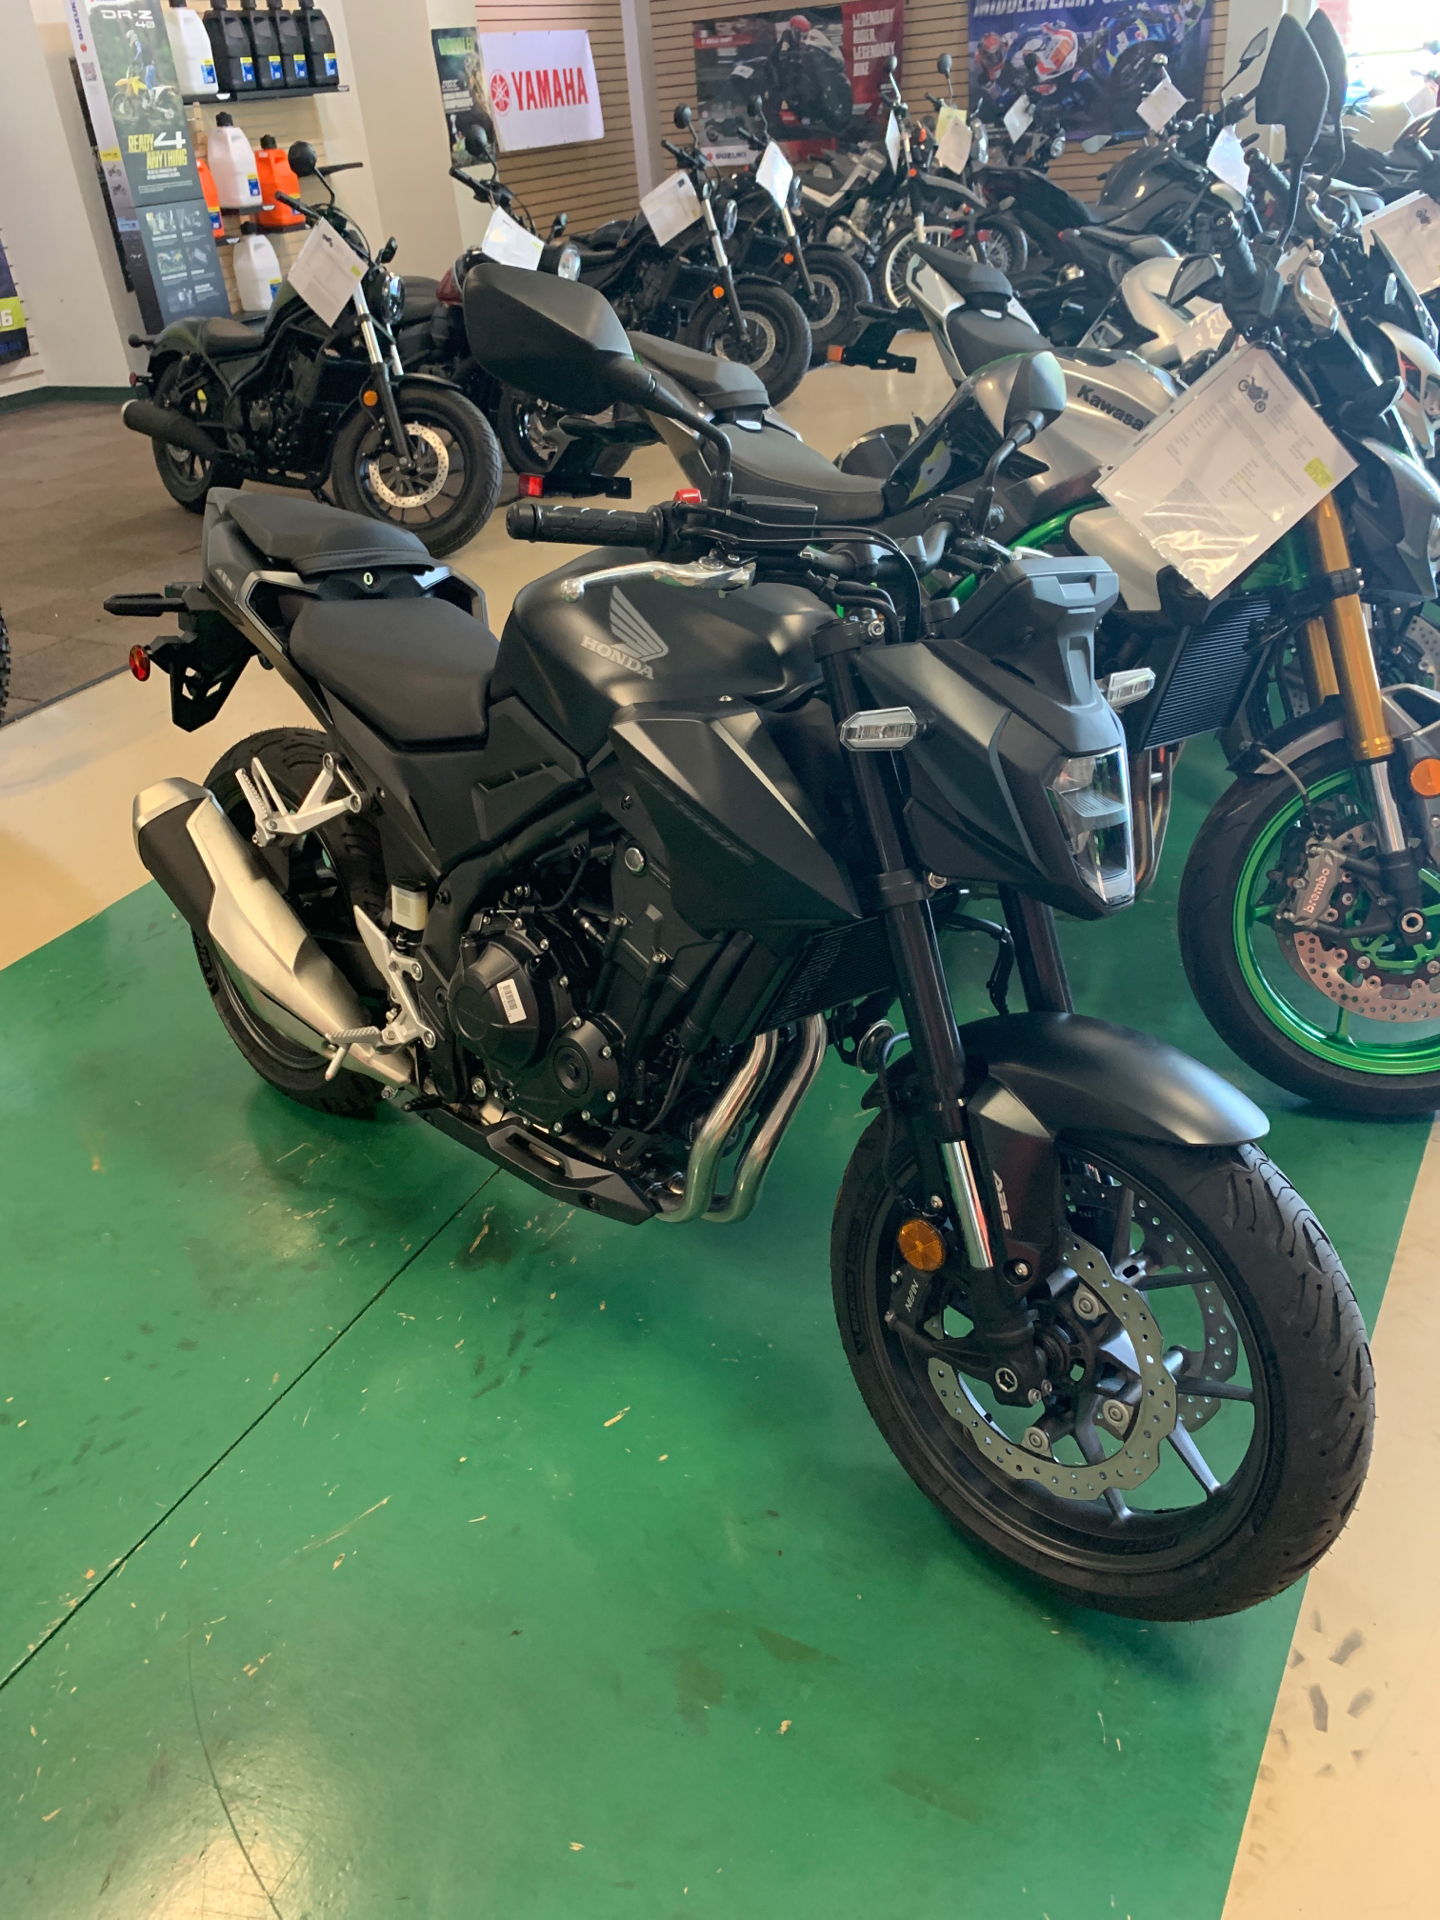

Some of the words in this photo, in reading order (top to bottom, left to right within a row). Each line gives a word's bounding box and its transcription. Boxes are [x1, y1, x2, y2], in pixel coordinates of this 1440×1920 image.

[100, 9, 153, 20] DR-Z
[852, 8, 895, 28] LEGENDARY
[853, 41, 895, 61] LEGENDARY
[511, 67, 589, 111] YAMAHA
[128, 133, 154, 154] READY
[153, 130, 187, 150] 4
[146, 148, 188, 170] ANYTHING
[1077, 384, 1152, 431] Kawasa
[580, 634, 654, 680] HONDA
[1303, 868, 1330, 914] brembo
[992, 1169, 1012, 1231] ABS
